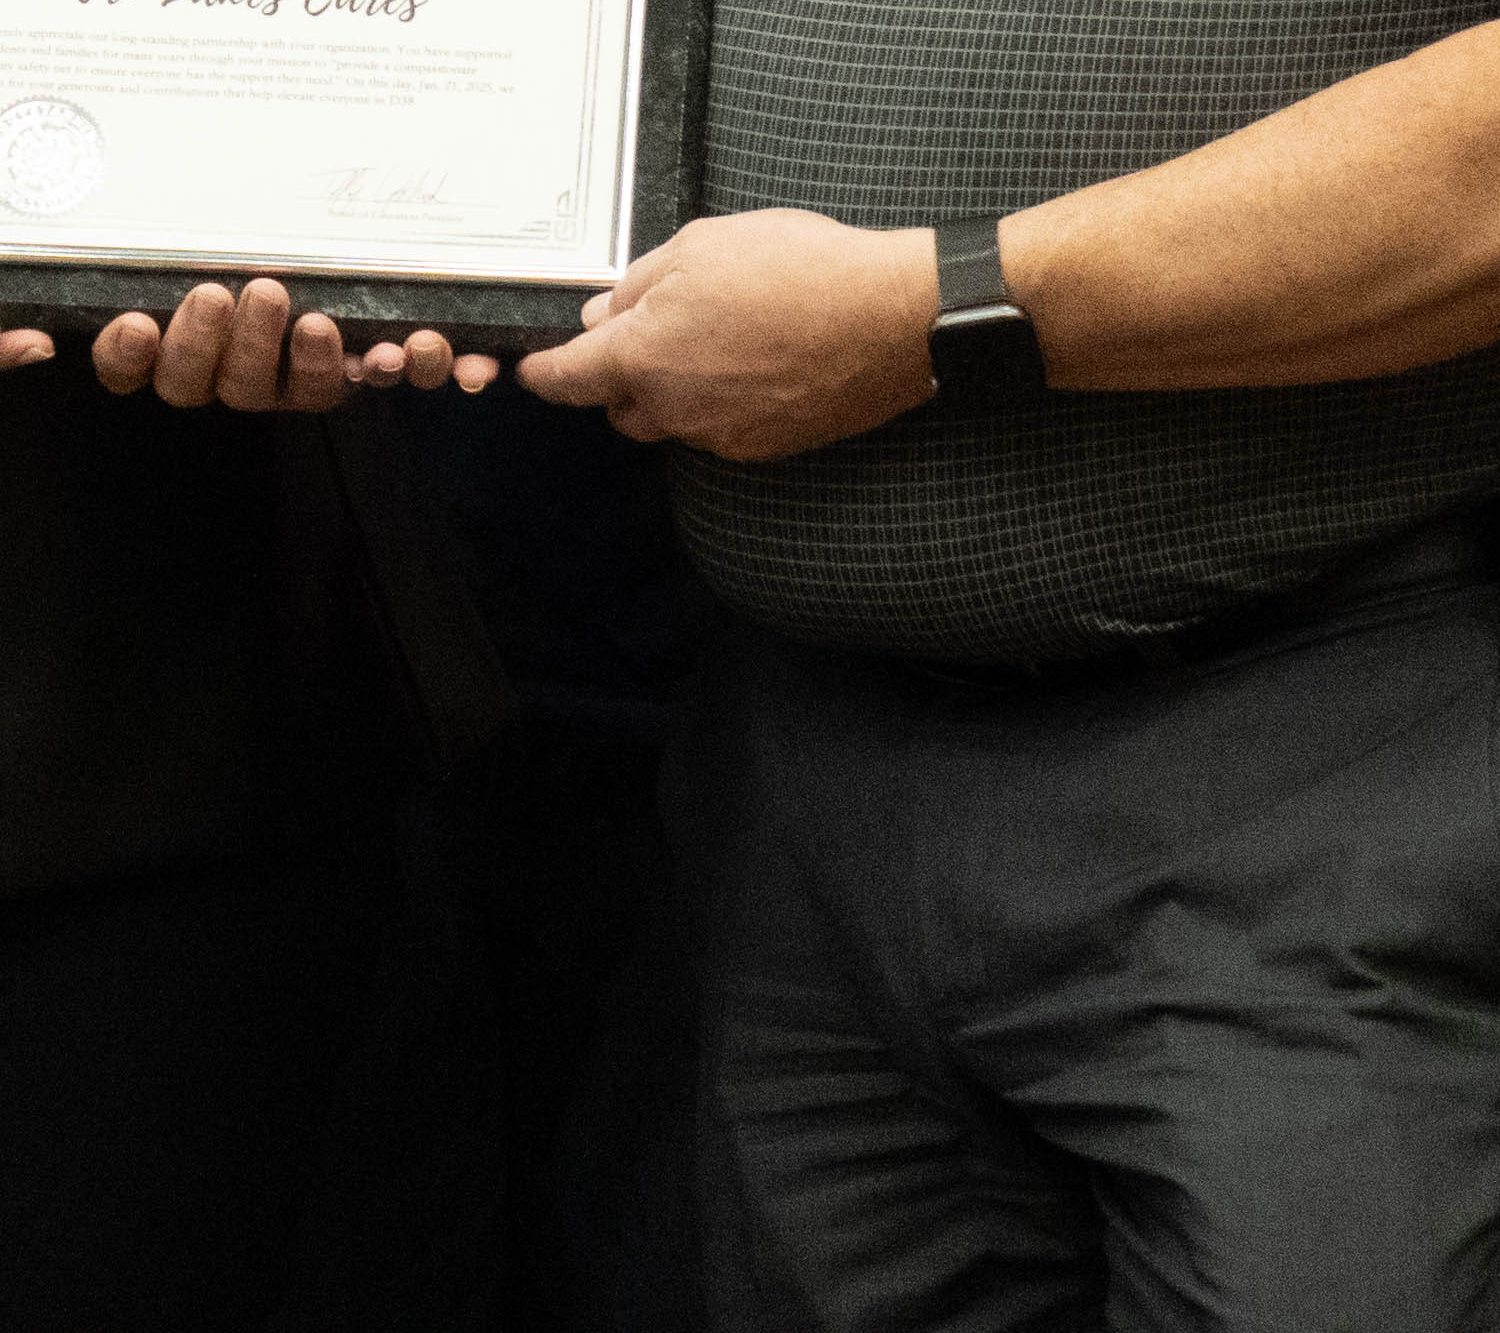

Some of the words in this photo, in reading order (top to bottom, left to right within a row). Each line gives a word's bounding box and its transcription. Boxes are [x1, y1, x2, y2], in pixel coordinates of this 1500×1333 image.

[30, 44, 52, 55] and
[55, 45, 98, 57] families
[101, 47, 118, 58] for
[189, 51, 234, 66] through
[262, 38, 286, 49] with
[424, 45, 449, 56] have
[454, 46, 513, 61] supported
[17, 61, 49, 75] safety
[207, 69, 225, 80] the
[228, 70, 274, 85] support
[7, 77, 25, 88] for
[118, 82, 140, 93] and
[223, 86, 245, 98] that
[248, 88, 273, 101] help
